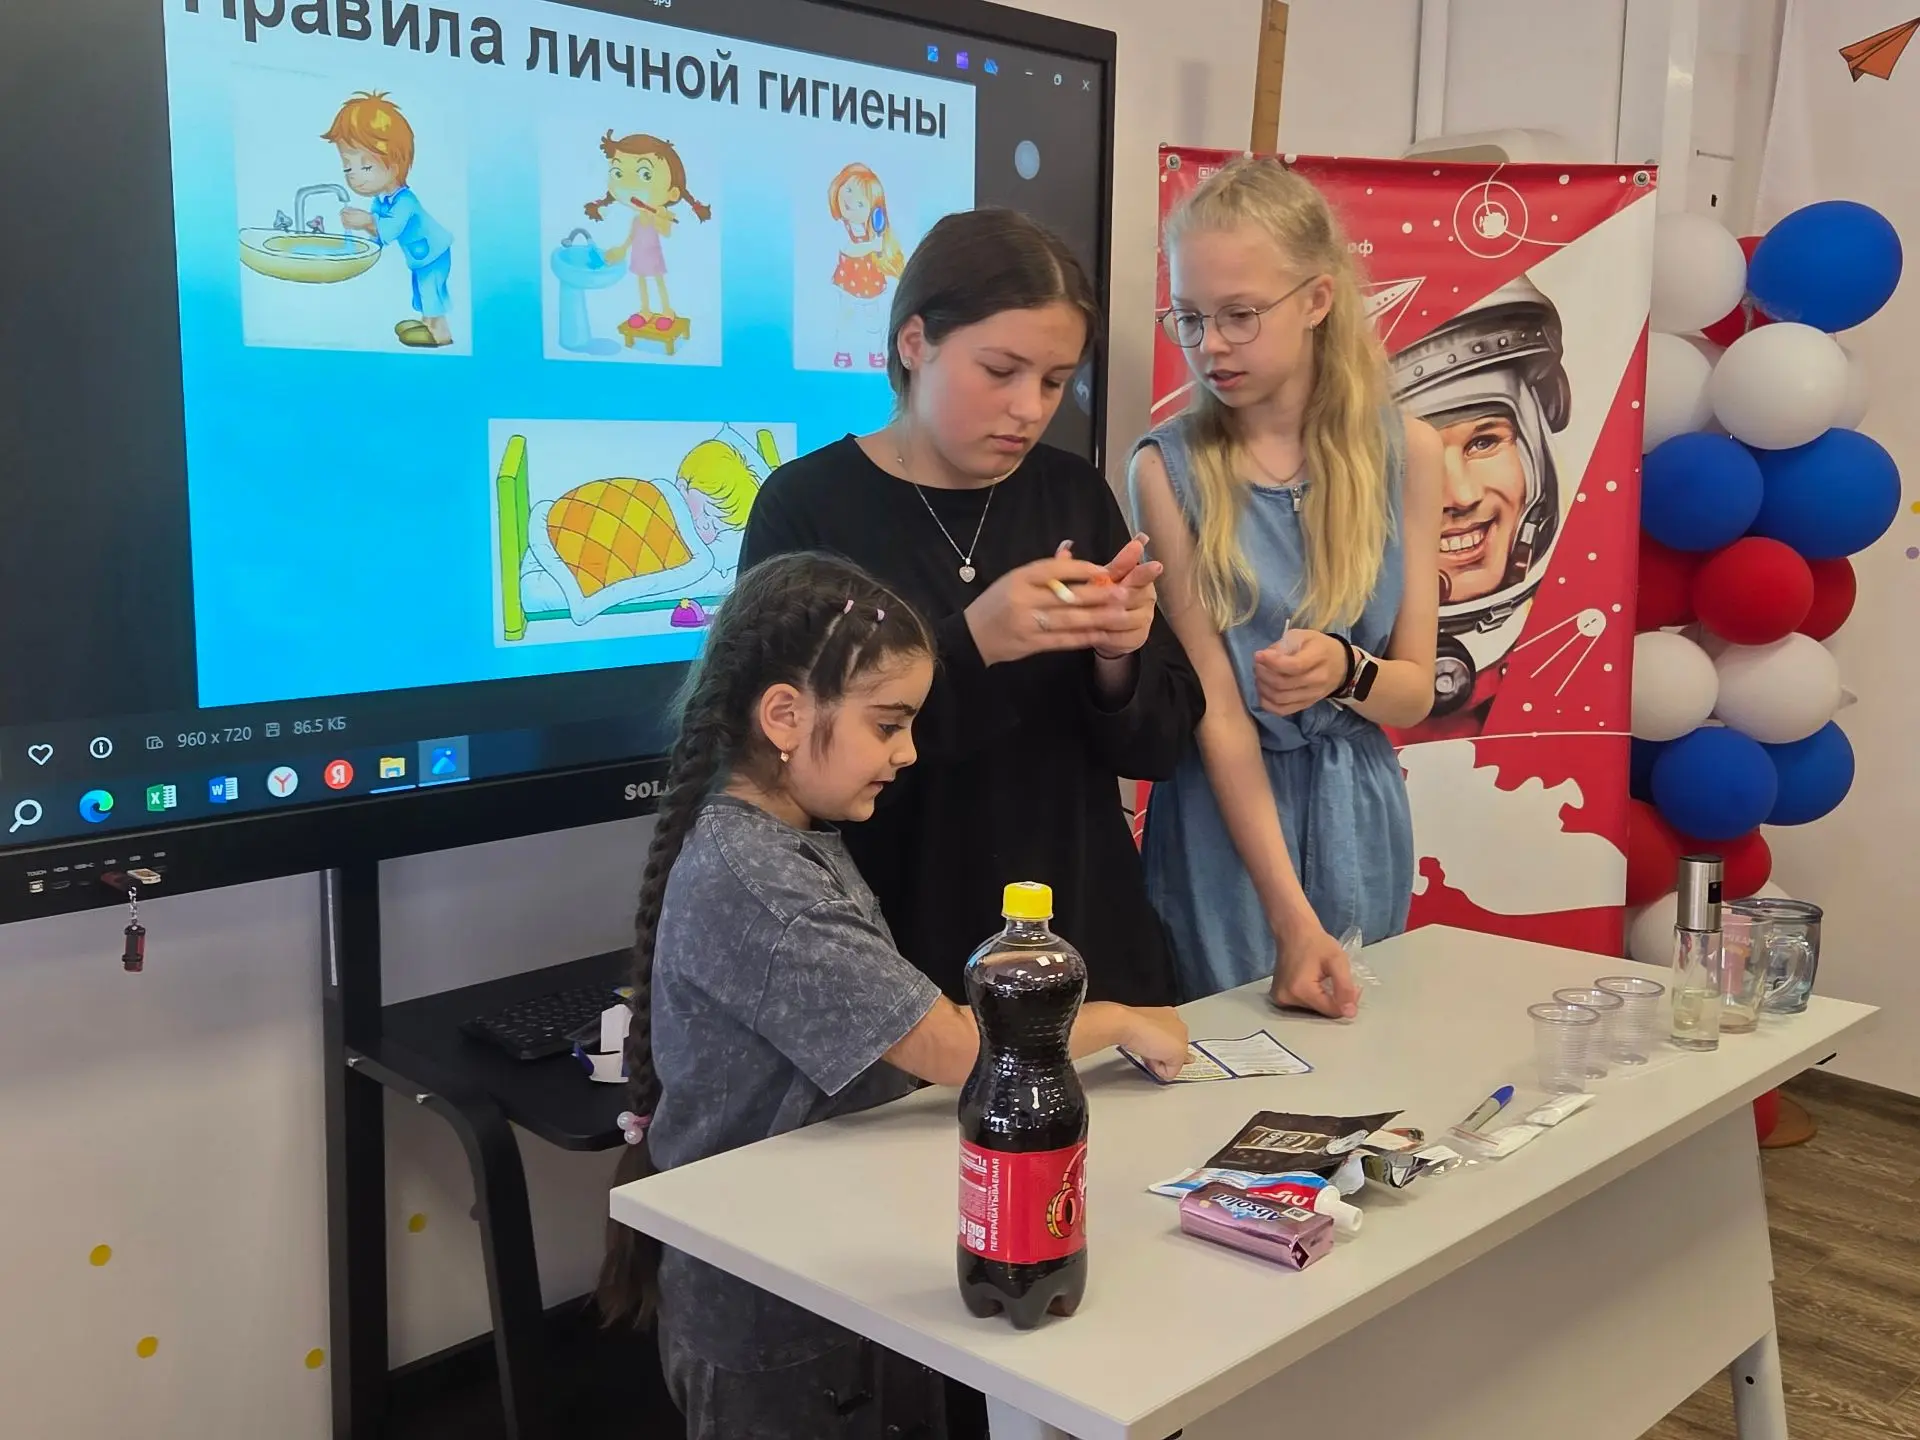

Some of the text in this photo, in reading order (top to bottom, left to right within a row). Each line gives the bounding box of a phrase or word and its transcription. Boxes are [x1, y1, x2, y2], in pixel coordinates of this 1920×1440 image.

[526, 26, 740, 106] личной
[758, 68, 947, 139] гигиены
[177, 731, 207, 748] 960
[223, 726, 252, 742] 720
[293, 715, 347, 735] 86.5 КБ
[989, 1157, 1001, 1252] ПЕРЕРАБАТЫВАЕМАЯ
[1211, 1192, 1286, 1222] Absolut
